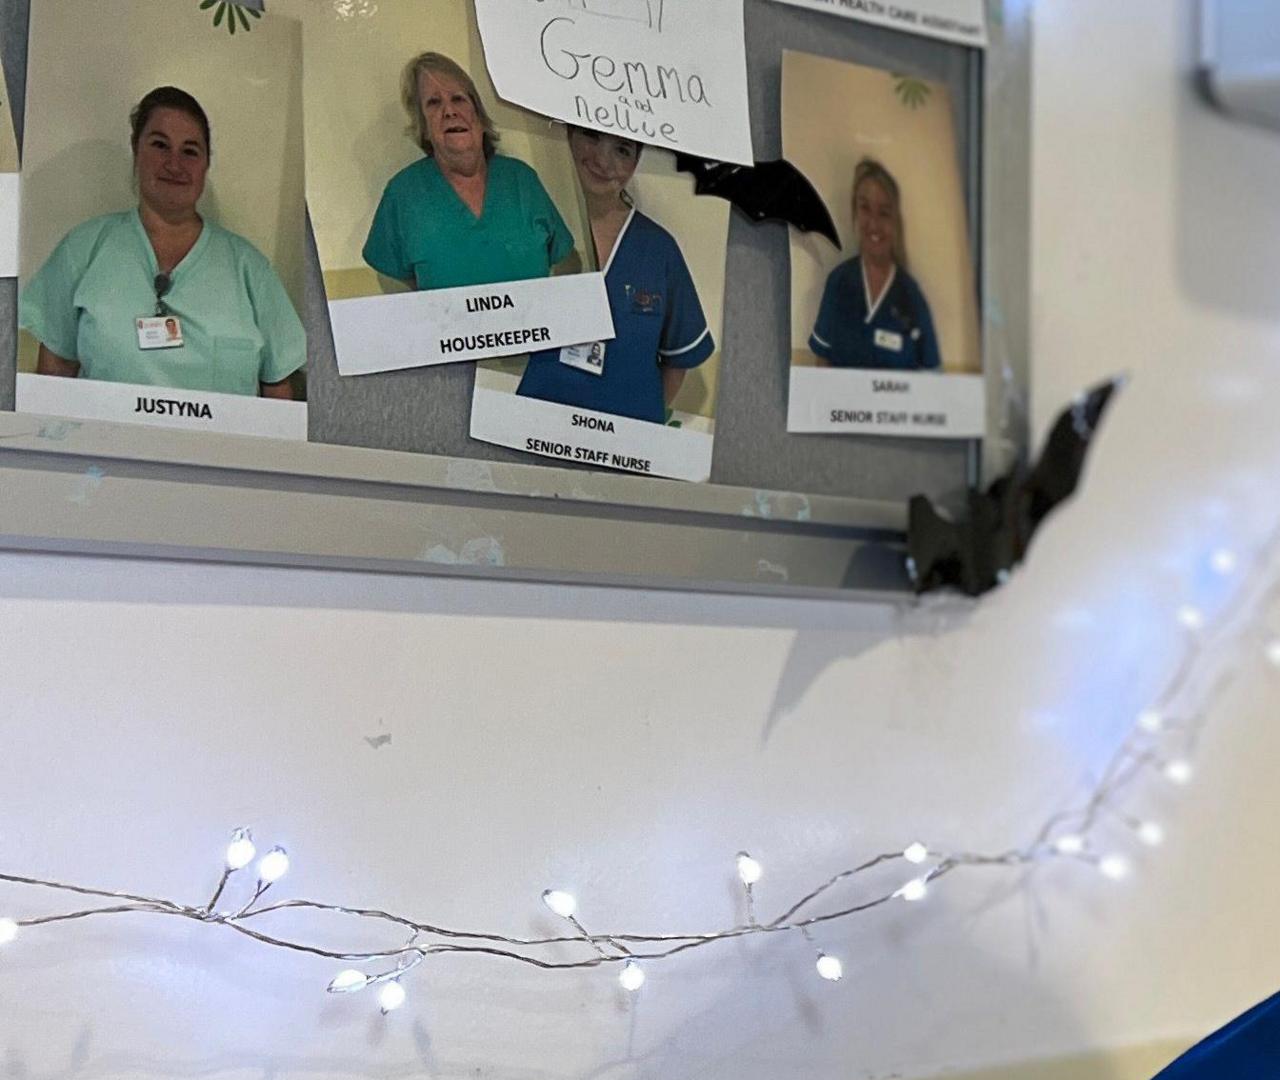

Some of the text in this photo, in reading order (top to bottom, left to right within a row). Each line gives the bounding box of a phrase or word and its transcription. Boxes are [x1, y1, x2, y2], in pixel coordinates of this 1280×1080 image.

[540, 16, 712, 107] Gemma
[619, 95, 654, 114] and
[466, 294, 515, 313] LINDA
[440, 327, 551, 354] HOUSEKEEPER
[135, 397, 213, 419] JUSTYNA
[830, 410, 873, 423] SENIOR
[571, 414, 615, 434] SHONA
[526, 437, 651, 472] SENIOR STAFF NURSE
